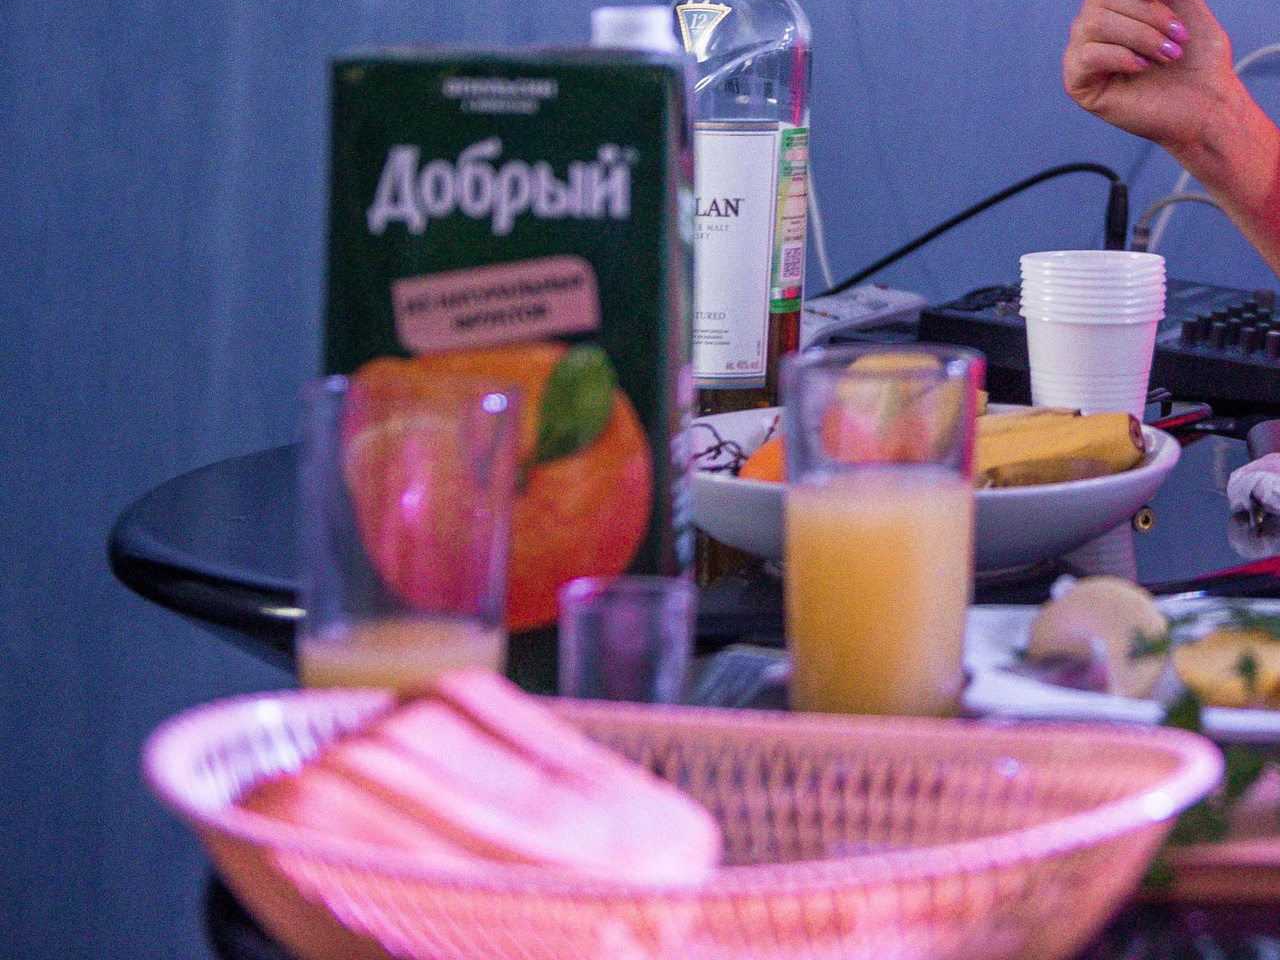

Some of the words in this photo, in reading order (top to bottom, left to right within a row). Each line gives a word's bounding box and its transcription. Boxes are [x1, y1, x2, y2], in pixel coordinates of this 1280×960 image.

[690, 13, 708, 29] 12
[366, 137, 633, 237] Добрый
[694, 197, 742, 218] LAN
[695, 311, 727, 320] TURED
